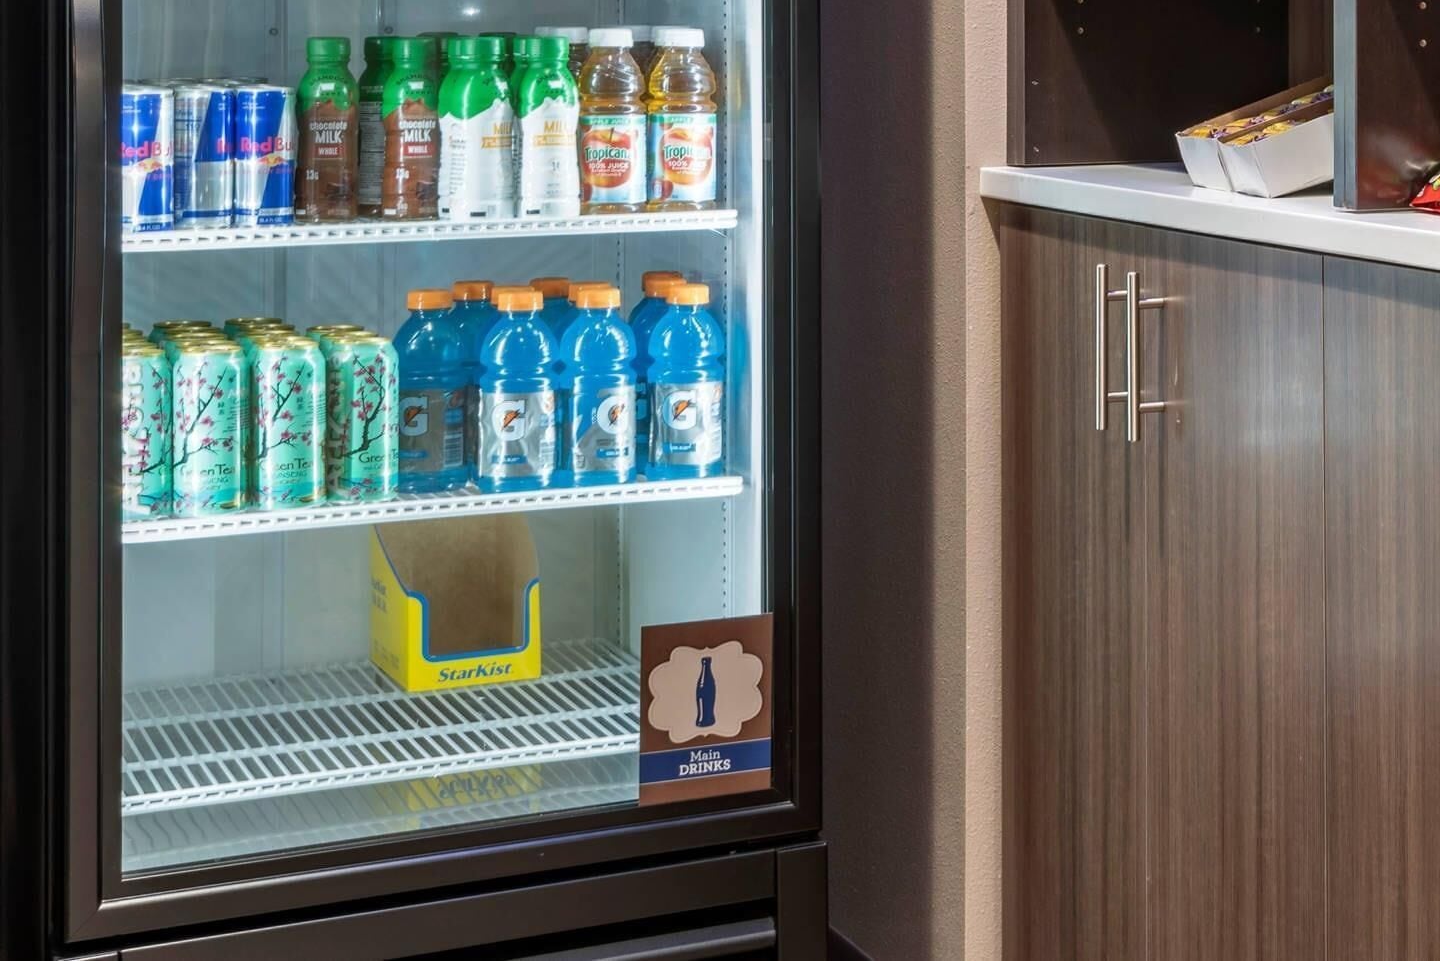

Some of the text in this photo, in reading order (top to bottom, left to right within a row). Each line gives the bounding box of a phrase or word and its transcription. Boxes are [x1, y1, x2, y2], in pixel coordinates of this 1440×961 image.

[309, 121, 348, 131] chocolate
[399, 120, 436, 130] chocolate
[315, 130, 342, 144] MILK
[404, 129, 431, 143] MILK
[240, 136, 272, 153] Red
[318, 147, 338, 155] WHOLE
[408, 146, 428, 154] WHOLE
[400, 396, 429, 436] G
[661, 390, 697, 430] G
[492, 399, 527, 441] G
[437, 662, 512, 683] StarKist
[690, 749, 721, 763] Main
[679, 758, 732, 776] DRINKS
